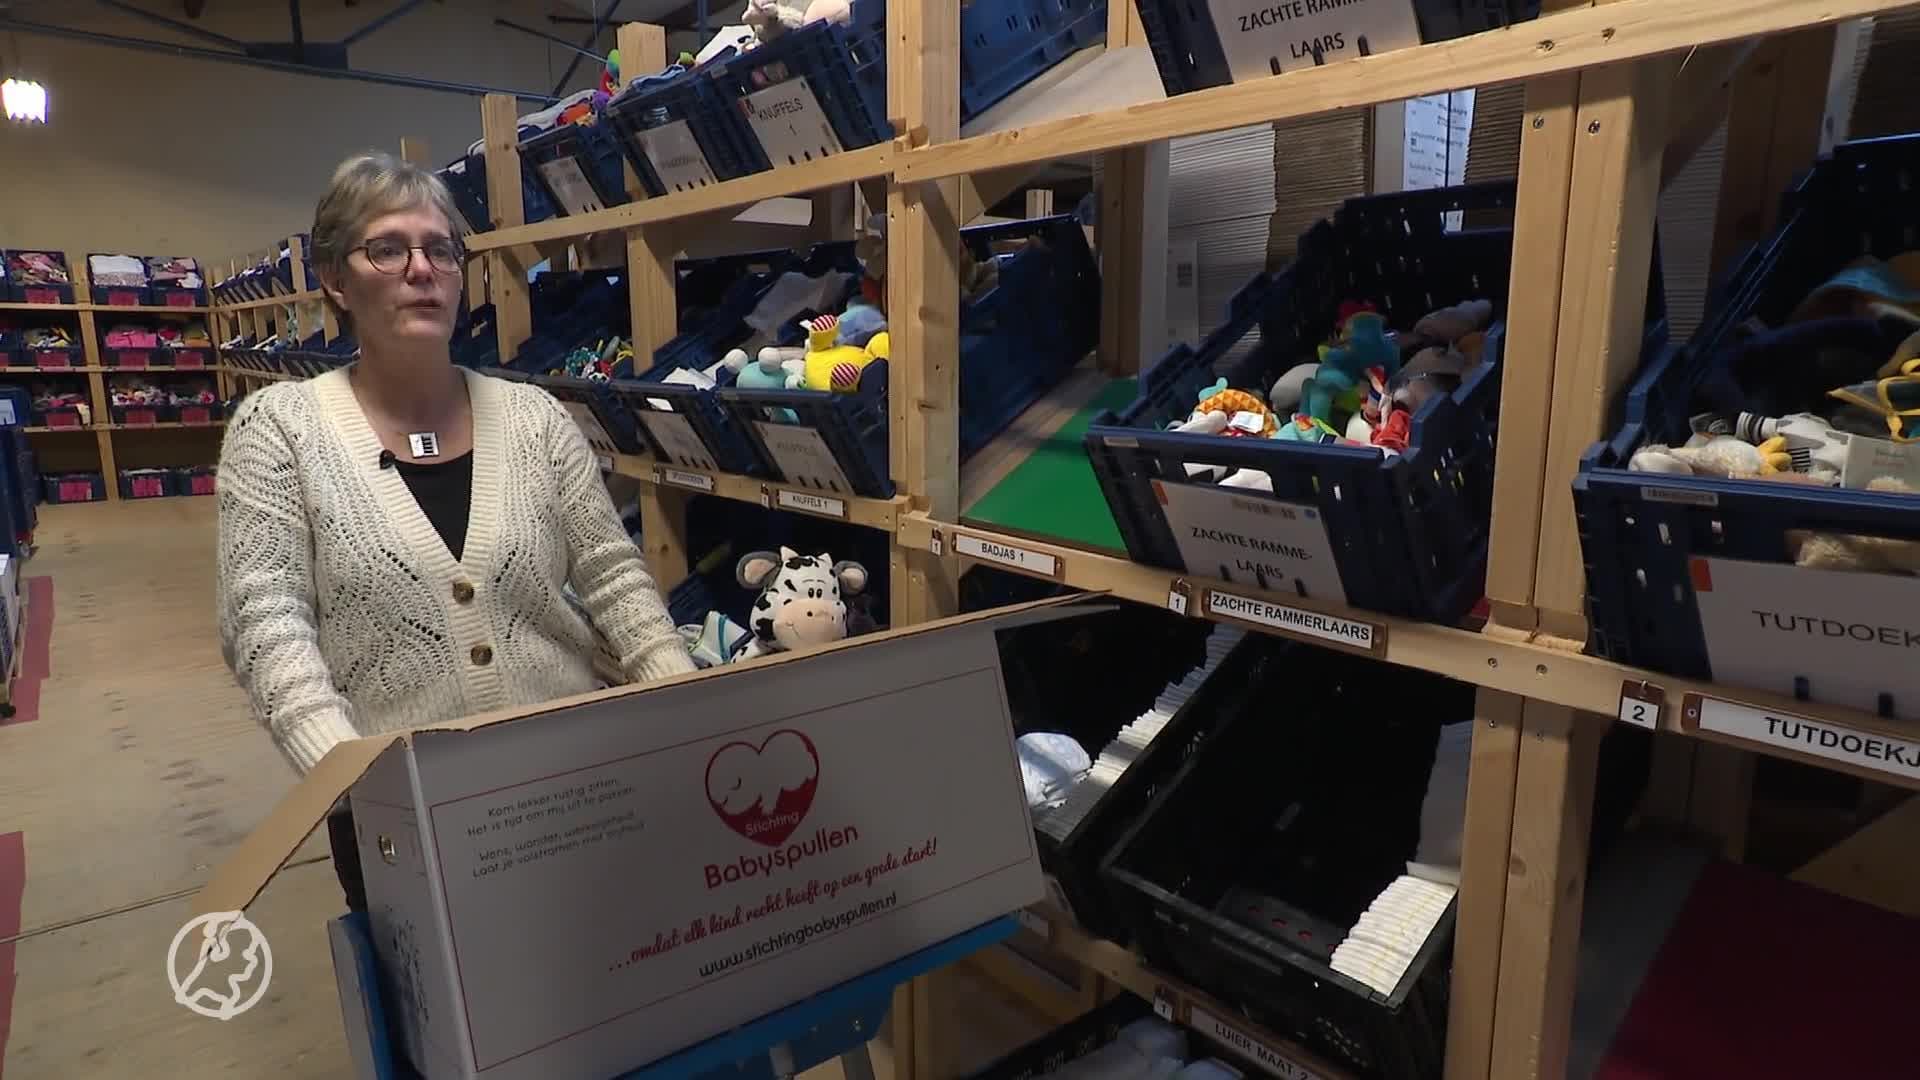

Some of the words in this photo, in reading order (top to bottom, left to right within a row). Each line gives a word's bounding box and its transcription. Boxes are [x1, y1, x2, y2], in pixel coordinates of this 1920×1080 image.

[1237, 2, 1304, 33] ZACHTE
[1305, 0, 1365, 15] RAM
[1290, 32, 1345, 60] LAARS
[758, 97, 803, 120] KNUFFELS
[981, 541, 1016, 561] BADJAS
[1019, 551, 1025, 563] 1
[1191, 526, 1251, 550] ZACHTE
[1235, 558, 1283, 581] LAARS
[1174, 597, 1182, 610] 1
[1212, 593, 1263, 617] ZACHTE
[1264, 606, 1371, 642] RAMMERLAARS
[1751, 610, 1920, 648] TUTDOEK
[1631, 704, 1646, 722] 2
[745, 811, 799, 835] Stichting
[704, 824, 859, 889] Babyspullen
[708, 905, 743, 936] kind
[745, 892, 784, 922] recht
[822, 878, 840, 899] op
[864, 851, 900, 888] goede
[901, 836, 937, 866] start!
[699, 890, 897, 978] www.stichtingbabyspullen.nl
[1215, 1022, 1252, 1052] LUIER
[1256, 1046, 1295, 1075] MAAT
